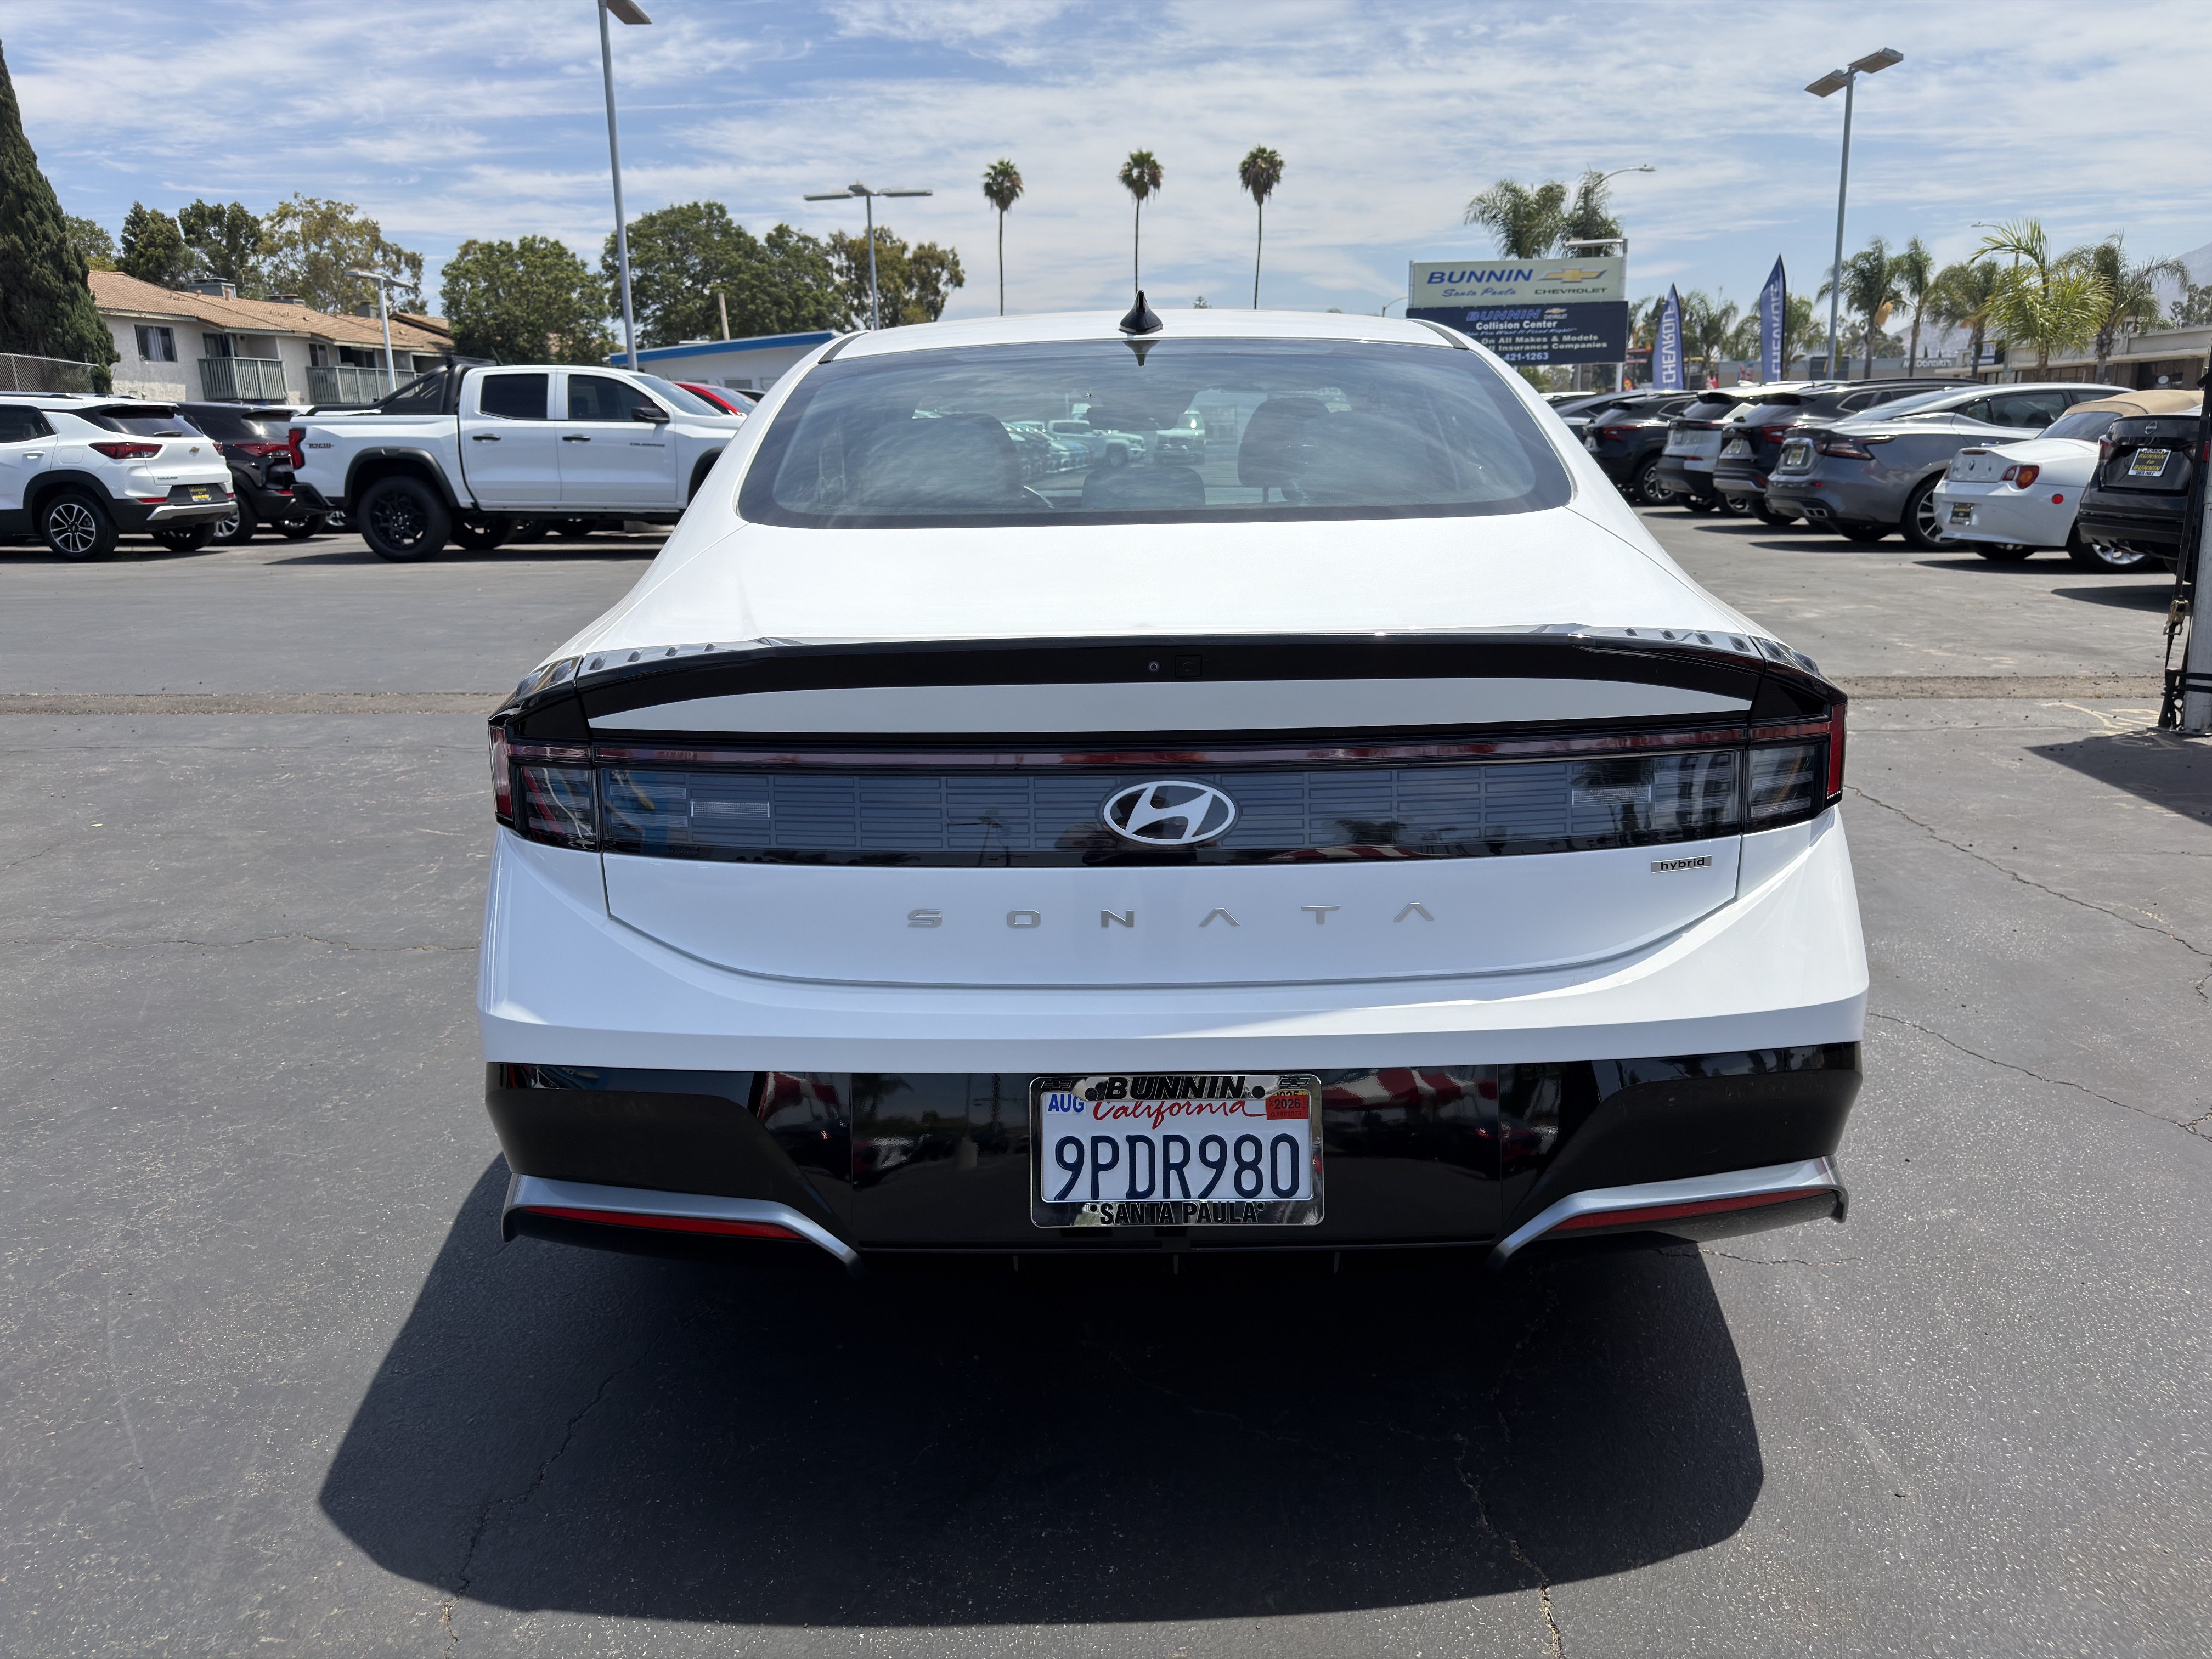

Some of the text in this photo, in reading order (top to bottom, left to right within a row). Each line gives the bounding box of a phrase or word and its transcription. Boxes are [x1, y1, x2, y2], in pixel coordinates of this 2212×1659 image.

[1427, 269, 1533, 284] BUNNIN
[1442, 287, 1476, 297] Santa
[1466, 308, 1541, 321] BUNNIN
[1476, 320, 1558, 330] Collision Center
[1504, 352, 1549, 361] 421-1263
[1661, 857, 1705, 870] hybrid
[907, 902, 1435, 929] SONATA
[1103, 1076, 1246, 1099] BUNNIN
[1048, 1094, 1084, 1113] AUG
[1274, 1098, 1301, 1109] 2026
[1093, 1100, 1266, 1130] California
[1054, 1133, 1300, 1200] 9PDR980
[1099, 1201, 1258, 1225] SANTA PAULA
